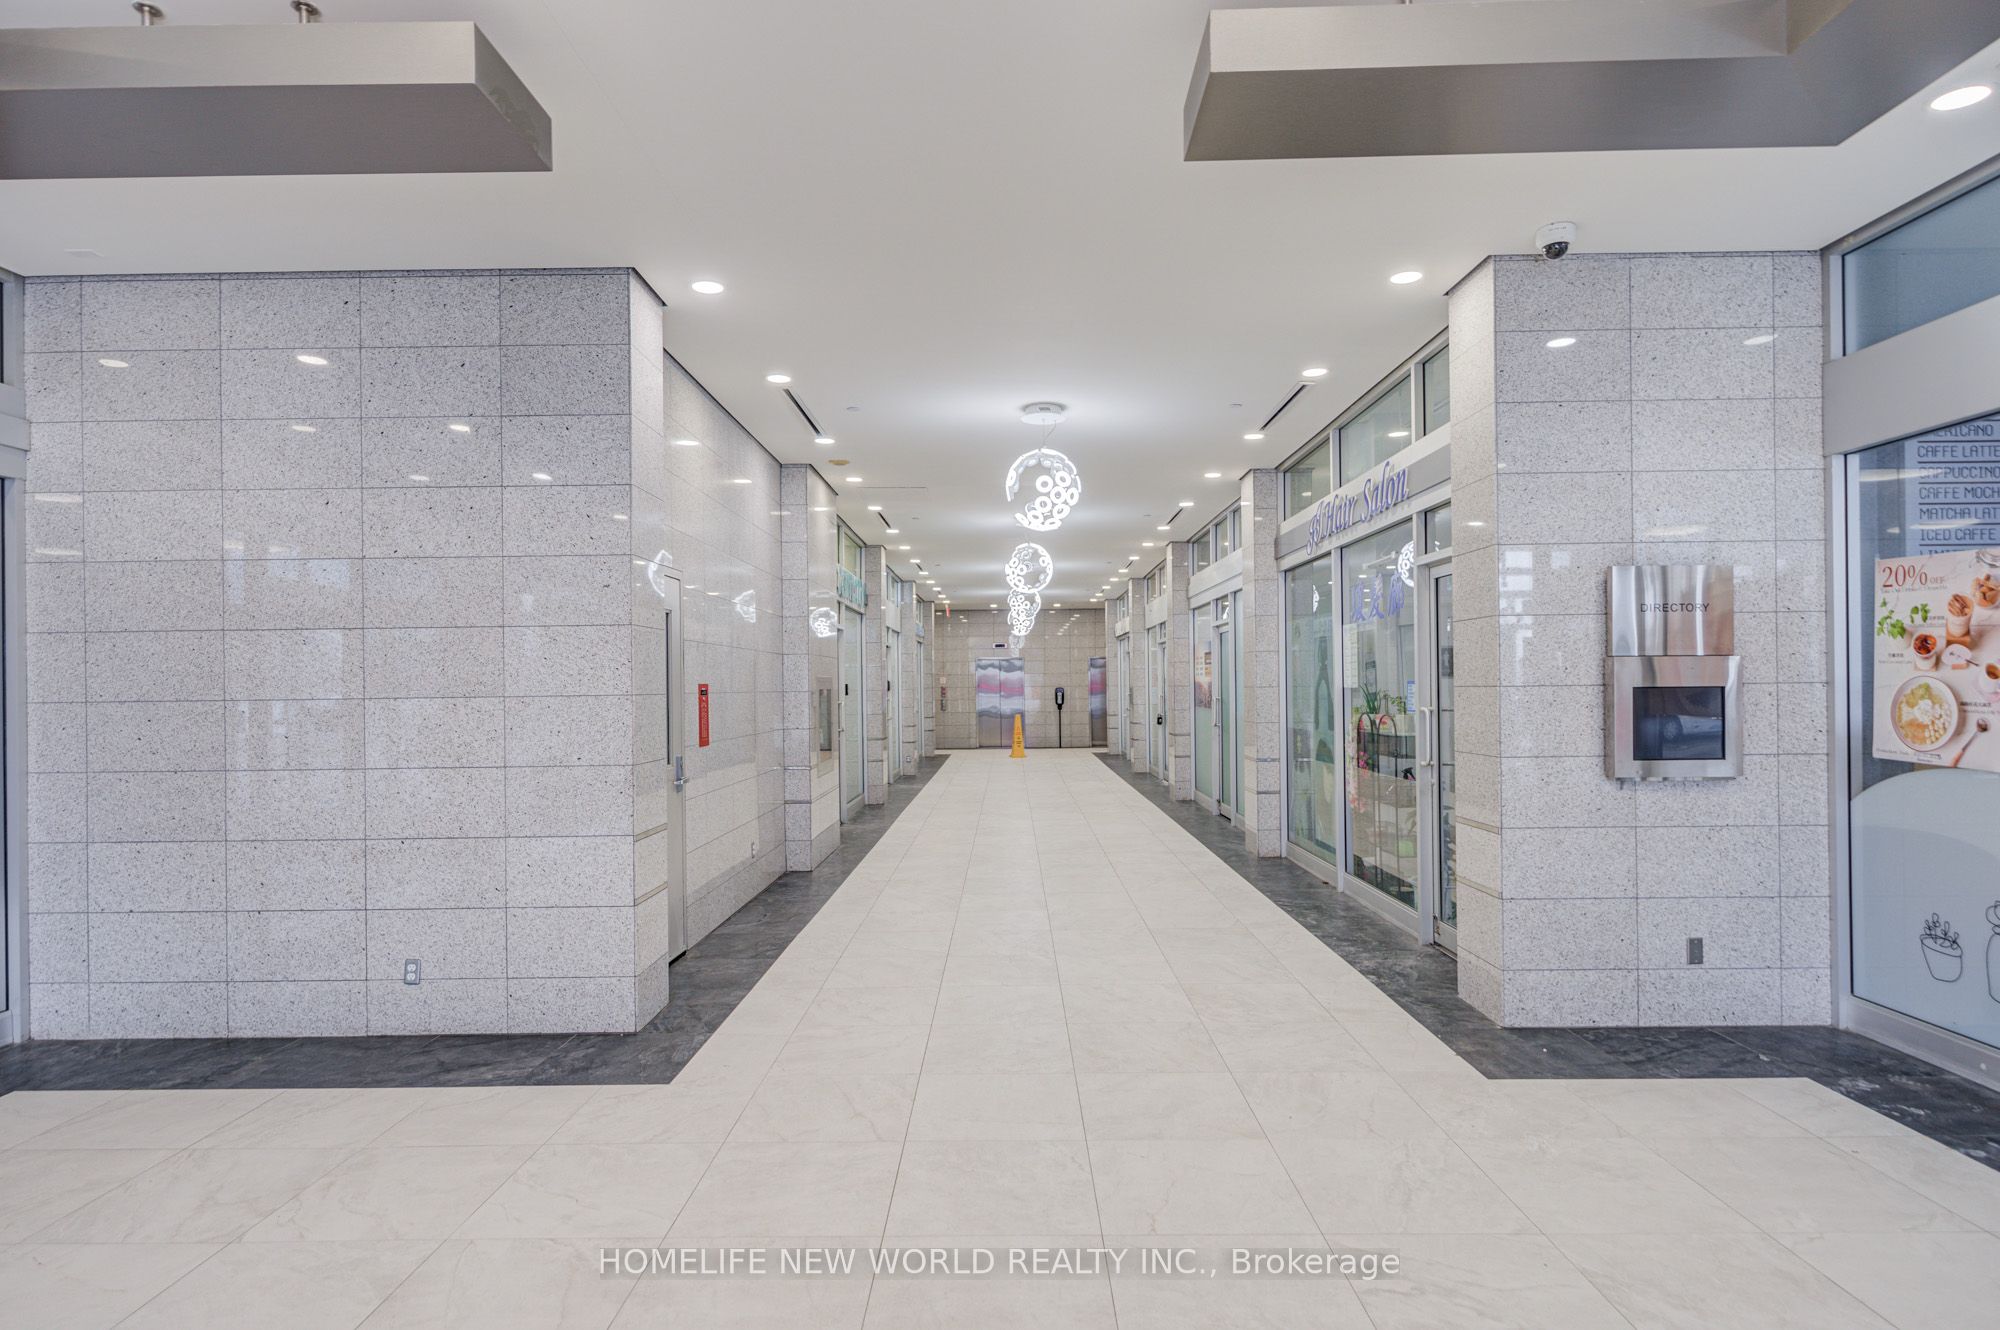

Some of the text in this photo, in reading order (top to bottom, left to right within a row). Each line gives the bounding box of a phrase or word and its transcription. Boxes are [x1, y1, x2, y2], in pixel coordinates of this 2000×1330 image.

[1917, 445, 2000, 458] CAFFE LATTE
[1919, 486, 1960, 499] CAFFE
[1322, 494, 1357, 539] Hair
[1360, 460, 1410, 522] Salon
[1919, 507, 1971, 520] MATCHA
[1920, 528, 1996, 541] ICED CAFFE
[1882, 564, 1946, 588] 20% OFF
[1640, 602, 1710, 613] DIRECTORY
